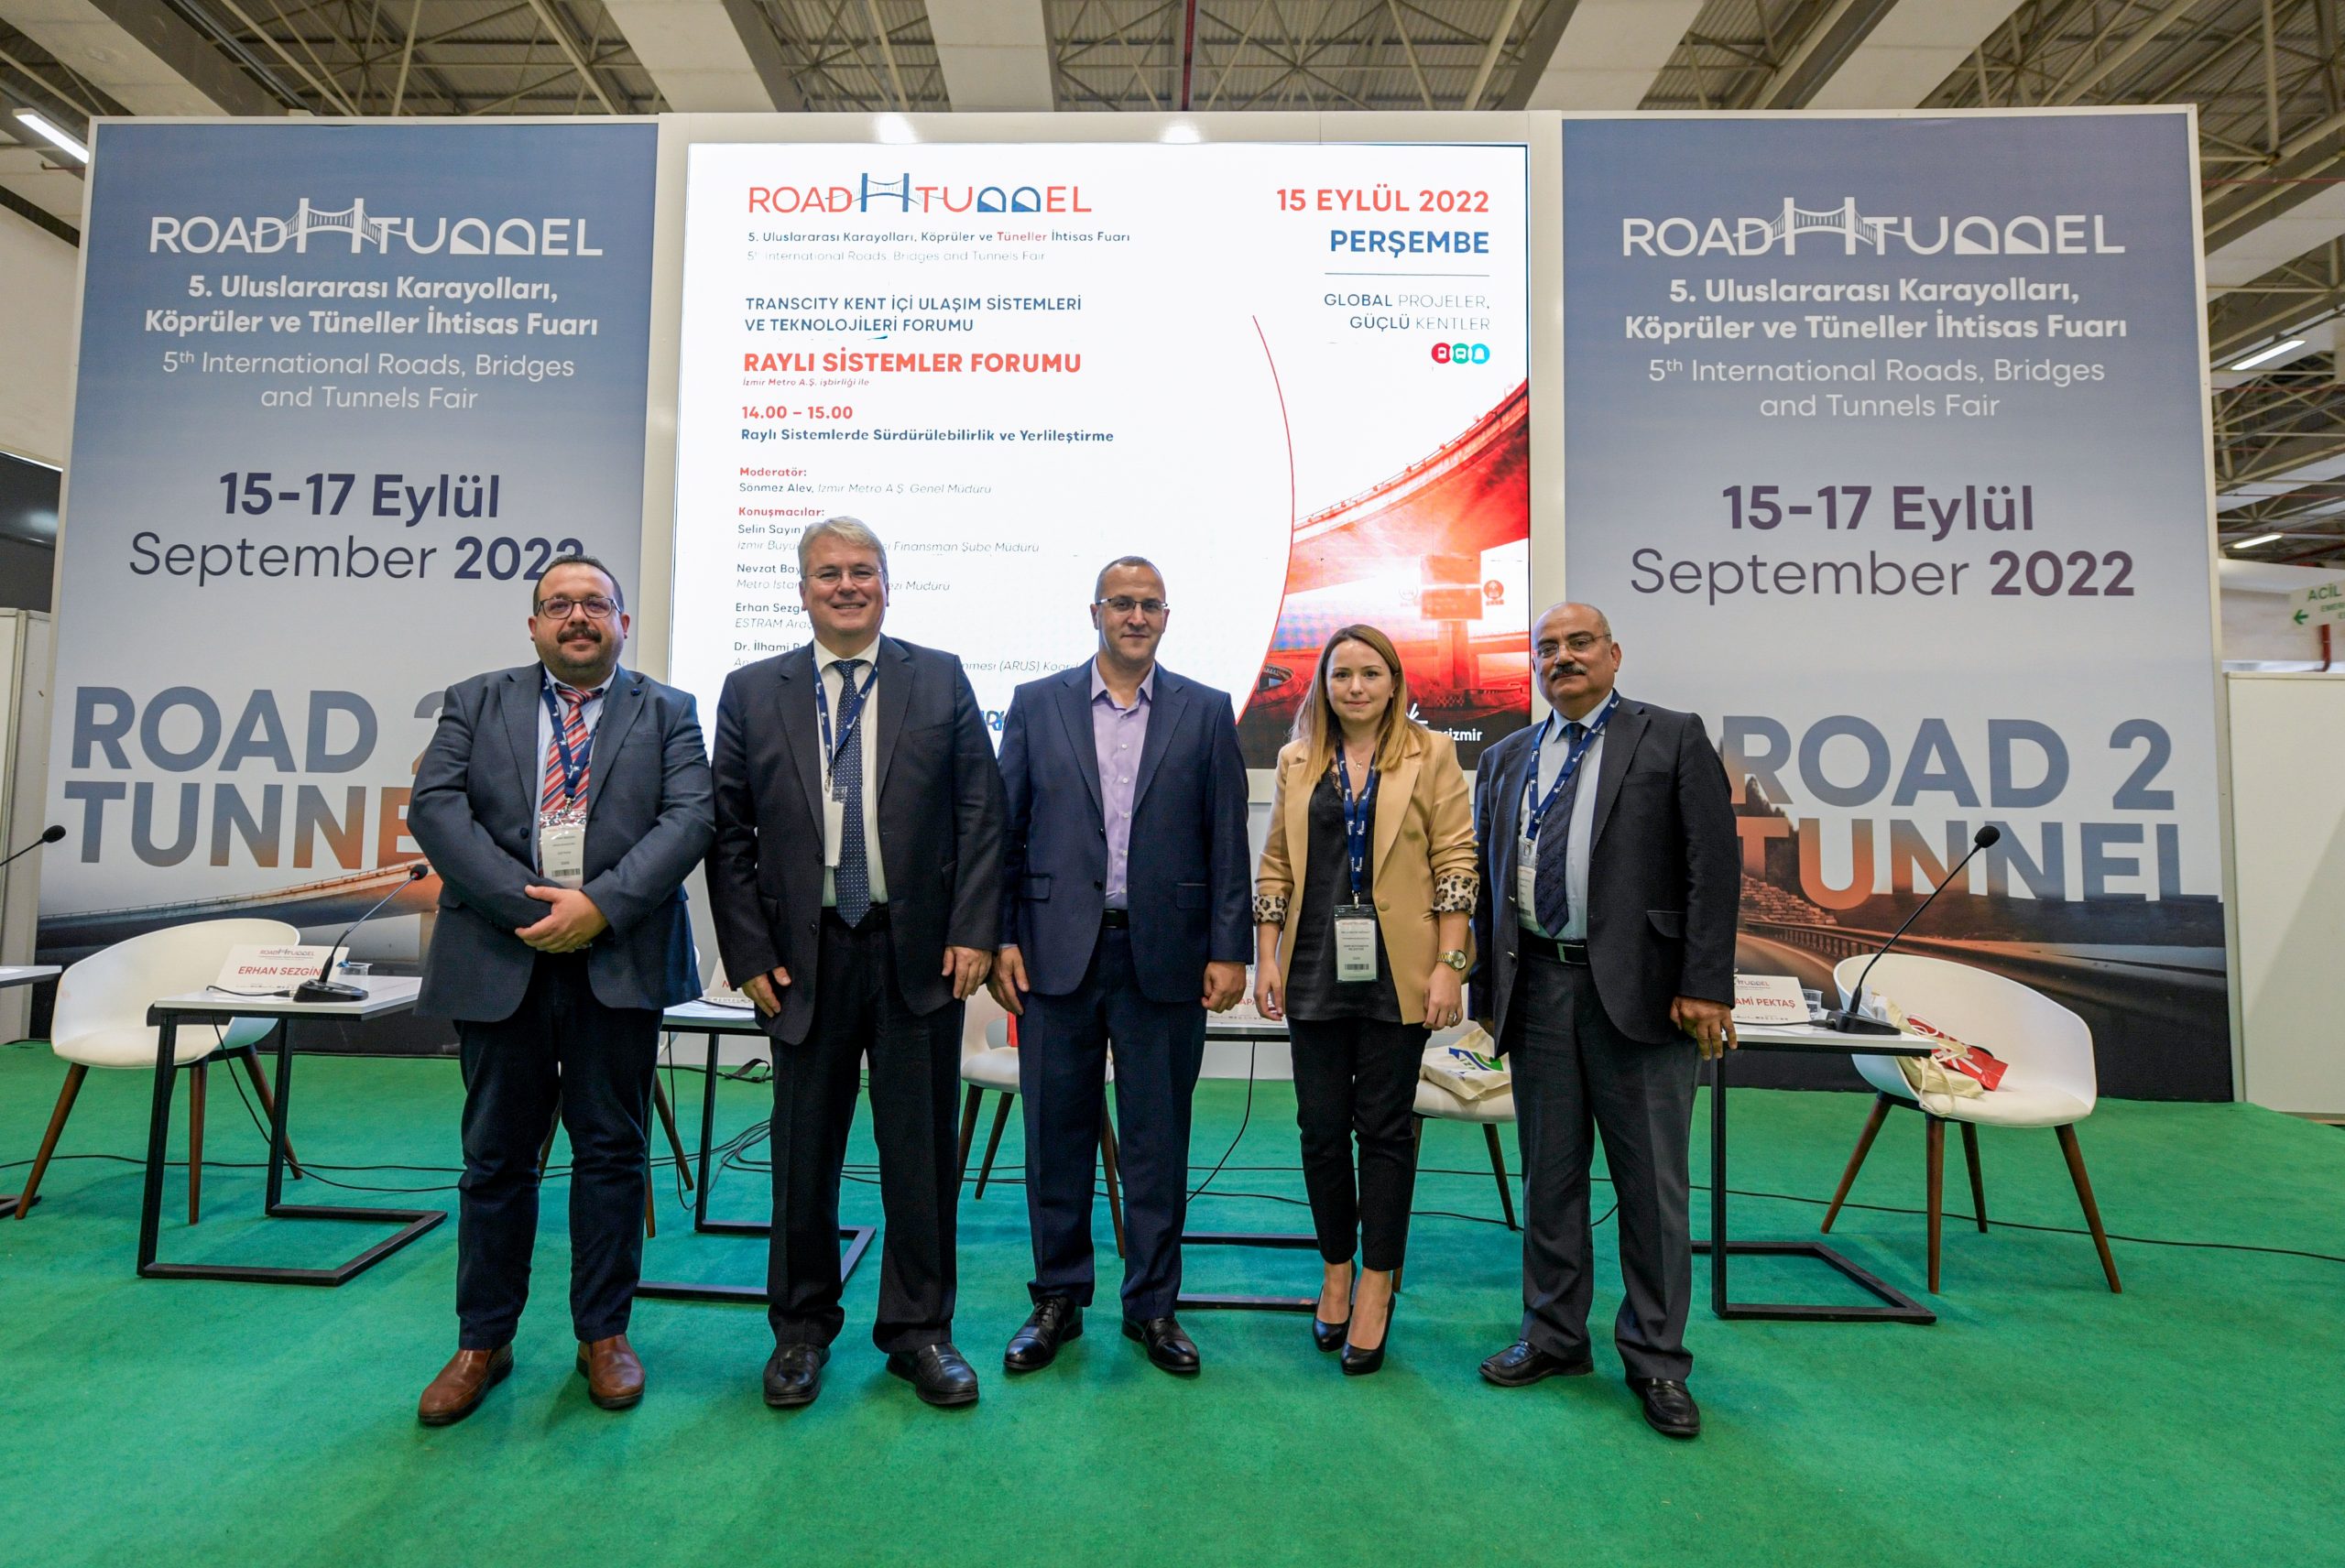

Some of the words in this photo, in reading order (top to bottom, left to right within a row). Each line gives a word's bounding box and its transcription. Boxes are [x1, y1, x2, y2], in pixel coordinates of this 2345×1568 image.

[1276, 188, 1306, 212] 15
[1316, 183, 1410, 212] EYLÜL
[1419, 190, 1489, 213] 2022
[747, 232, 758, 242] 5.
[763, 232, 840, 242] Uluslararası
[843, 232, 917, 245] Karayolları,
[921, 231, 976, 244] Köprüler
[997, 231, 1048, 242] Tüneller
[1052, 229, 1094, 242] İhtisas
[1097, 231, 1130, 242] Fuarı
[1330, 229, 1489, 258] PERŞEMBE
[765, 250, 846, 262] International
[893, 250, 940, 264] Bridges
[943, 250, 968, 261] and
[972, 250, 1019, 261] Tunnels
[1021, 250, 1045, 261] Fair
[188, 275, 213, 298] 5.
[221, 275, 387, 299] Uluslararası
[396, 276, 558, 304] Karayolları,
[1669, 278, 1696, 302] 5.
[1705, 278, 1890, 302] Uluslararası
[1899, 277, 2079, 307] Karayolları,
[746, 298, 839, 310] TRANSCITY
[844, 298, 887, 310] KENT
[891, 294, 913, 313] İÇİ
[919, 298, 981, 313] ULAŞIM
[987, 294, 1082, 310] SİSTEMLERİ
[1324, 293, 1393, 308] GLOBAL
[1398, 294, 1490, 310] PROJELER,
[145, 310, 263, 338] Köprüler
[269, 314, 301, 333] ve
[308, 310, 420, 334] Tüneller
[427, 305, 519, 335] İhtisas
[527, 312, 598, 336] Fuarı
[745, 319, 766, 332] VE
[769, 315, 898, 332] TEKNOLOJİLERİ
[902, 319, 974, 332] FORUMU
[1349, 313, 1411, 332] GÜÇLÜ
[1415, 316, 1490, 331] KENTLER
[1625, 315, 1755, 344] Köprüler
[1762, 321, 1797, 339] ve
[1805, 315, 1928, 339] Tüneller
[1936, 308, 2039, 338] İhtisas
[2047, 314, 2127, 338] Fuarı
[162, 350, 195, 374] 5th
[202, 351, 369, 375] International
[377, 353, 466, 378] Roads,
[475, 354, 575, 383] Bridges
[744, 353, 814, 372] RAYLI
[823, 346, 963, 373] SİSTEMLER
[971, 353, 1081, 373] FORUMU
[1648, 358, 1684, 382] 5th
[1692, 358, 1876, 382] International
[1886, 358, 1985, 385] Roads,
[1994, 358, 2105, 388] Bridges
[742, 377, 766, 387] İzmir
[768, 377, 797, 387] Metro
[799, 377, 817, 387] A.Ş.
[820, 377, 856, 388] işbirliği
[857, 377, 870, 387] ile
[260, 385, 312, 408] and
[322, 385, 420, 408] Tunnels
[428, 387, 478, 409] Fair
[1760, 394, 1816, 417] and
[1825, 393, 1936, 417] Tunnels
[1946, 393, 2001, 417] Fair
[741, 406, 788, 419] 14.00
[807, 406, 854, 419] 15.00
[741, 428, 777, 443] Raylı
[780, 428, 869, 441] Sistemlerde
[873, 428, 995, 441] Sürdürülebilirlik
[999, 432, 1016, 441] ve
[1020, 429, 1114, 444] Yerlileştirme
[739, 467, 808, 477] Moderatör:
[738, 483, 784, 493] Sönmez
[787, 483, 814, 495] Alev,
[848, 483, 882, 495] Metro
[910, 484, 944, 495] Genel
[219, 472, 355, 517] 15-17
[371, 474, 500, 528] Eylül
[738, 506, 825, 518] Konuşmacılar:
[1722, 485, 1872, 531] 15-17
[1892, 485, 2034, 542] Eylül
[737, 524, 766, 534] Selin
[769, 524, 802, 536] Sayın
[893, 540, 958, 552] Finansman
[128, 530, 437, 587] September
[736, 563, 777, 573] Nevzat
[1630, 547, 1969, 606] September
[1989, 550, 2135, 597] 2022
[736, 579, 770, 590] Metro
[735, 602, 769, 613] Erhan
[735, 617, 783, 628] ESTRAM
[734, 642, 750, 652] Dr.
[754, 639, 790, 652] İlhami
[999, 659, 1041, 673] (ARUS)
[71, 685, 378, 774] ROAD
[1720, 714, 2070, 810] ROAD
[2108, 717, 2176, 811] 2
[1737, 815, 2223, 911] TUNNEL
[237, 965, 278, 975] ERHAN
[279, 964, 322, 976] SEZGİN
[1756, 997, 1796, 1009] PEKTAŞ
